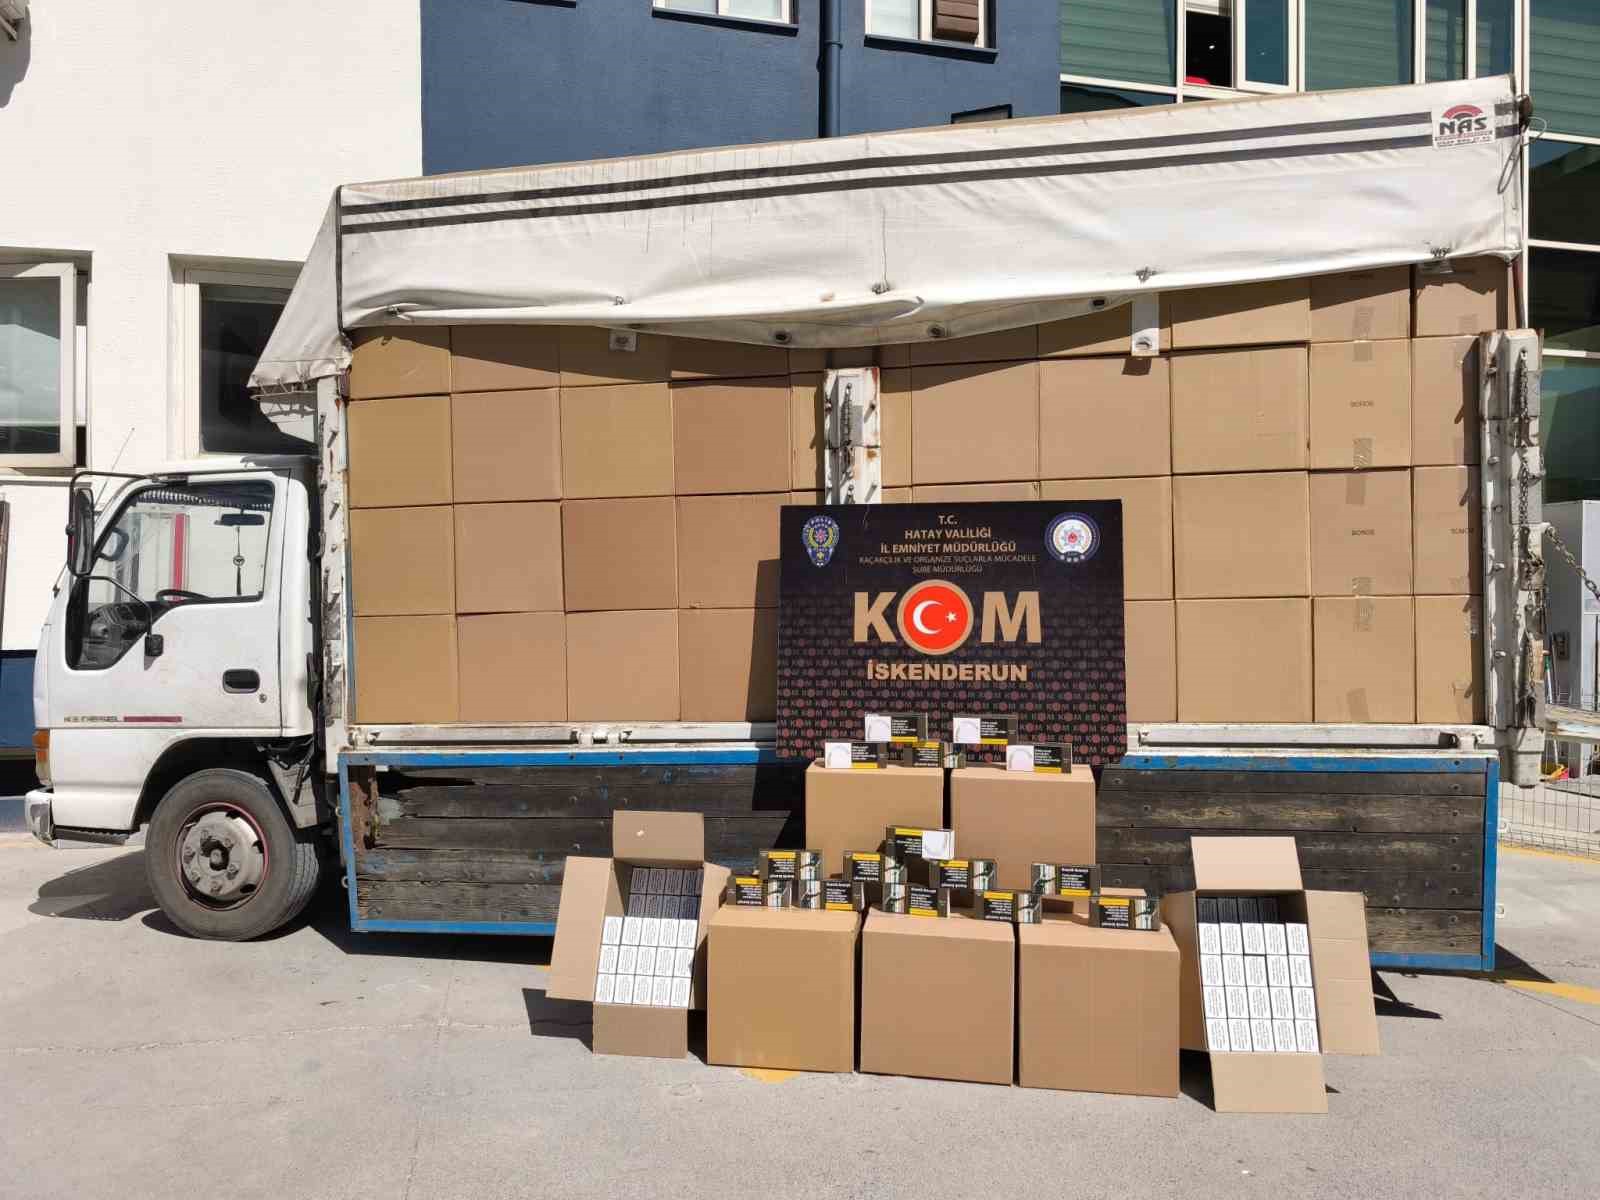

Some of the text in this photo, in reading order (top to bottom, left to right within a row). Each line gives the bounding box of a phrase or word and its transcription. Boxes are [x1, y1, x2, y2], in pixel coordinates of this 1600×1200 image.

[938, 514, 958, 525] T.C.
[904, 526, 992, 540] HATAY VALİLİĞİ
[880, 539, 1017, 554] İL EMNİYET MÜDÜRLÜĞÜ
[867, 659, 1028, 681] İSKENDERUN
